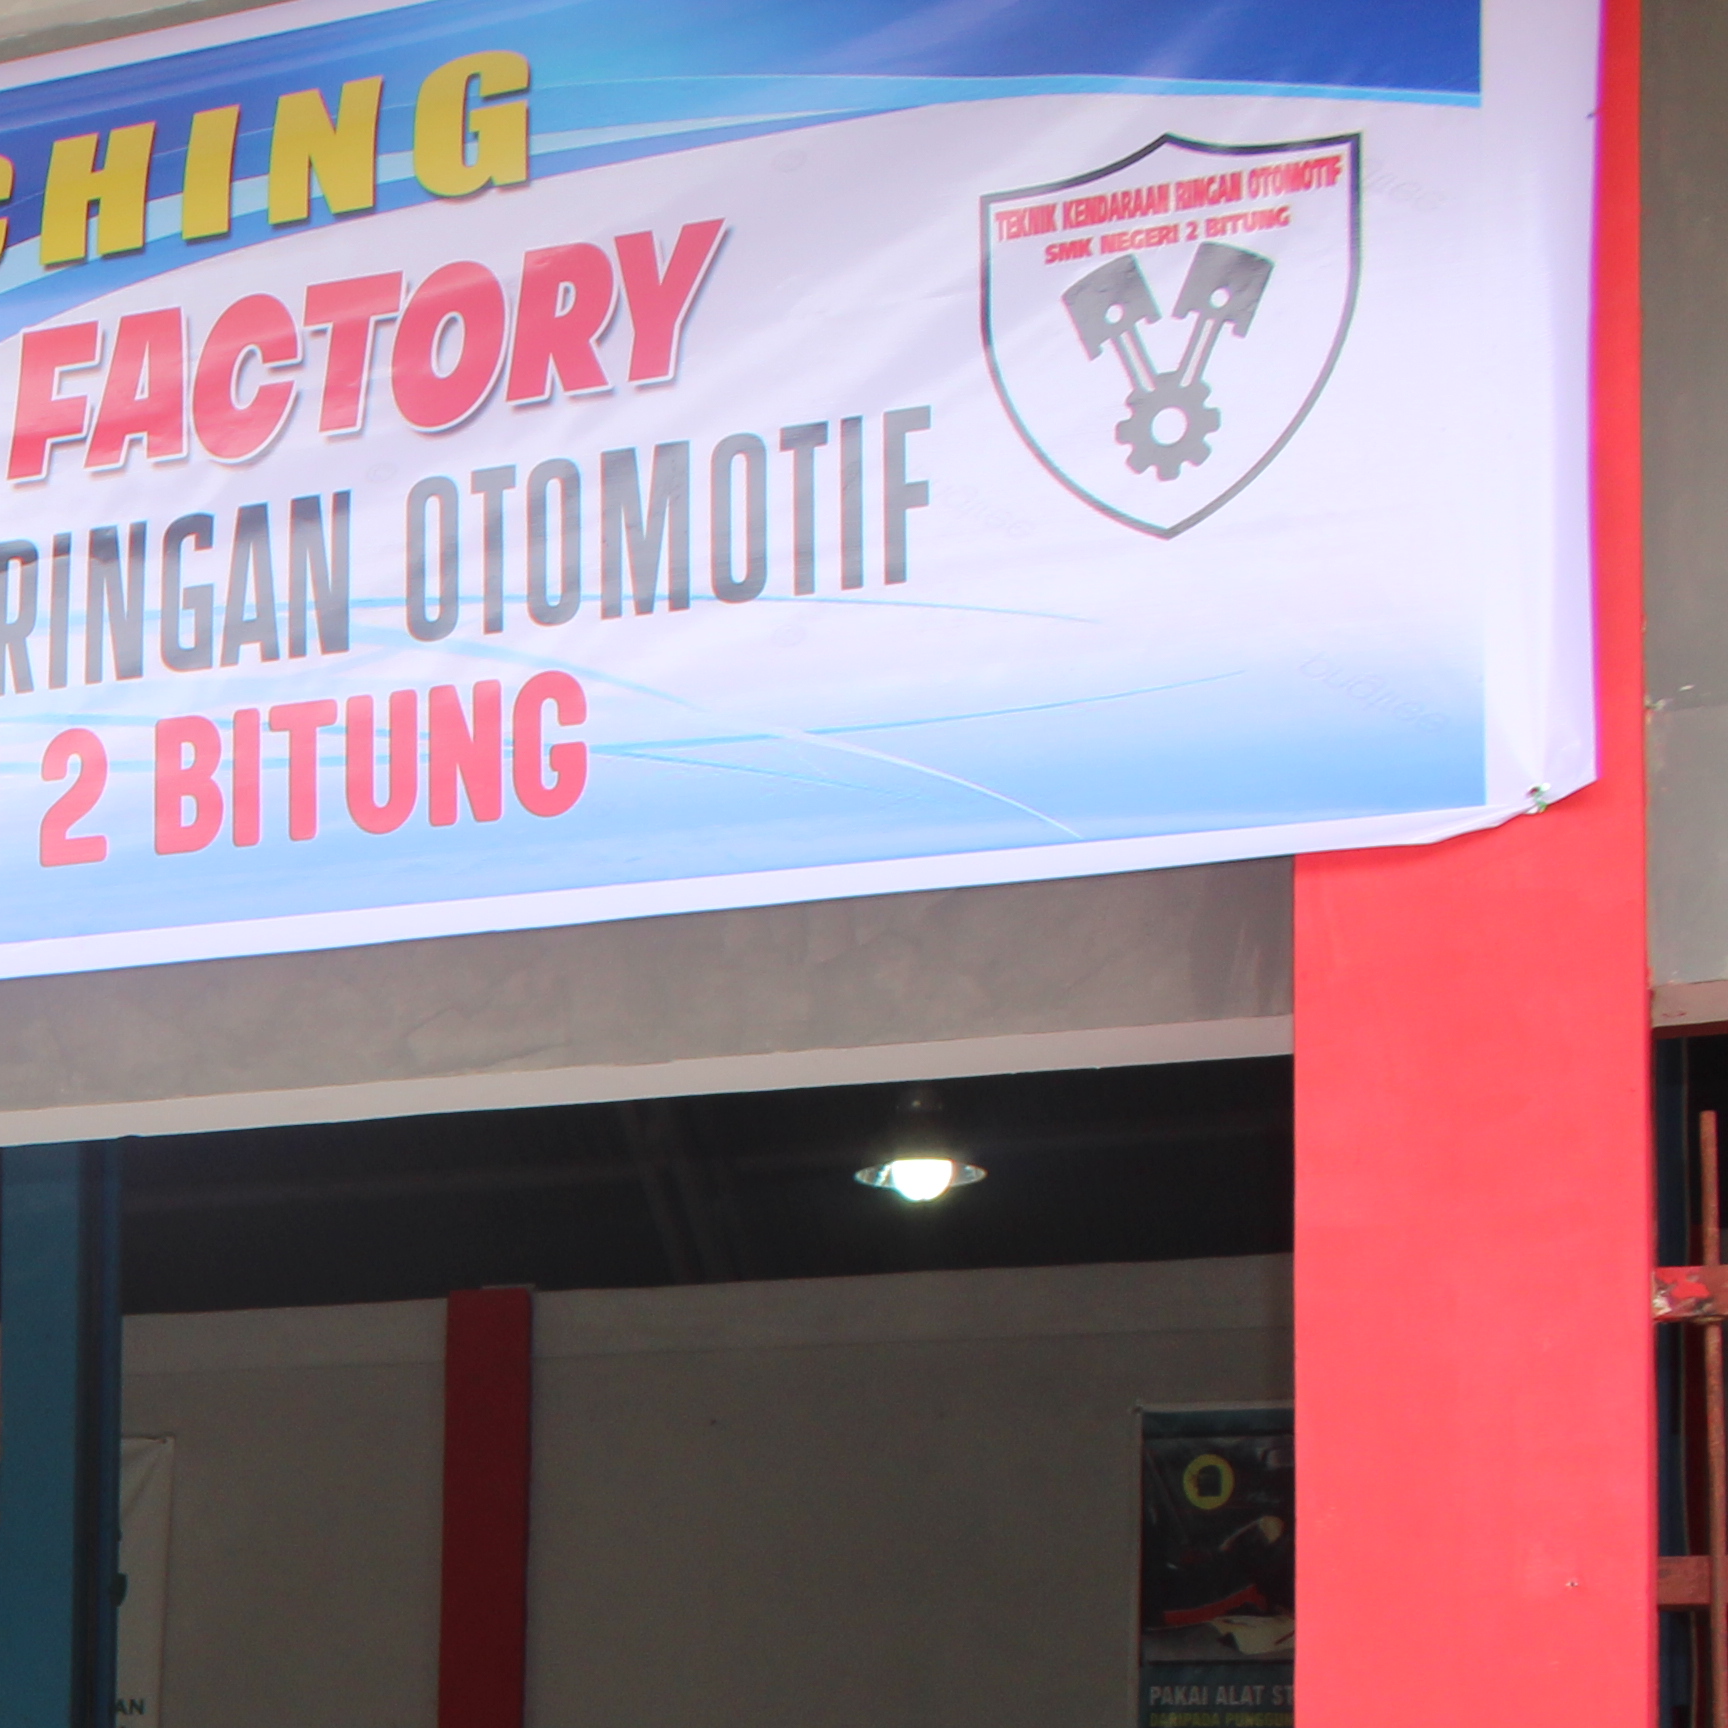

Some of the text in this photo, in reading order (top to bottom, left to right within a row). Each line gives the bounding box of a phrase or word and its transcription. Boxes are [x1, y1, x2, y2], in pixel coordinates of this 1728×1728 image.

[995, 202, 1058, 242] TEKNIK
[1063, 183, 1170, 231] KENDARAAN
[1175, 171, 1242, 212] RINGAN
[1248, 154, 1342, 198] OTOMOTIF
[1044, 205, 1290, 265] SMK NEGERI 2 BITUNG
[4, 217, 728, 483] FACTORY
[405, 405, 932, 643] OTOMOTIF
[39, 727, 109, 869] 2
[153, 670, 590, 857] BITUNG
[1149, 1685, 1208, 1707] PAKAI
[1216, 1684, 1264, 1706] ALAT
